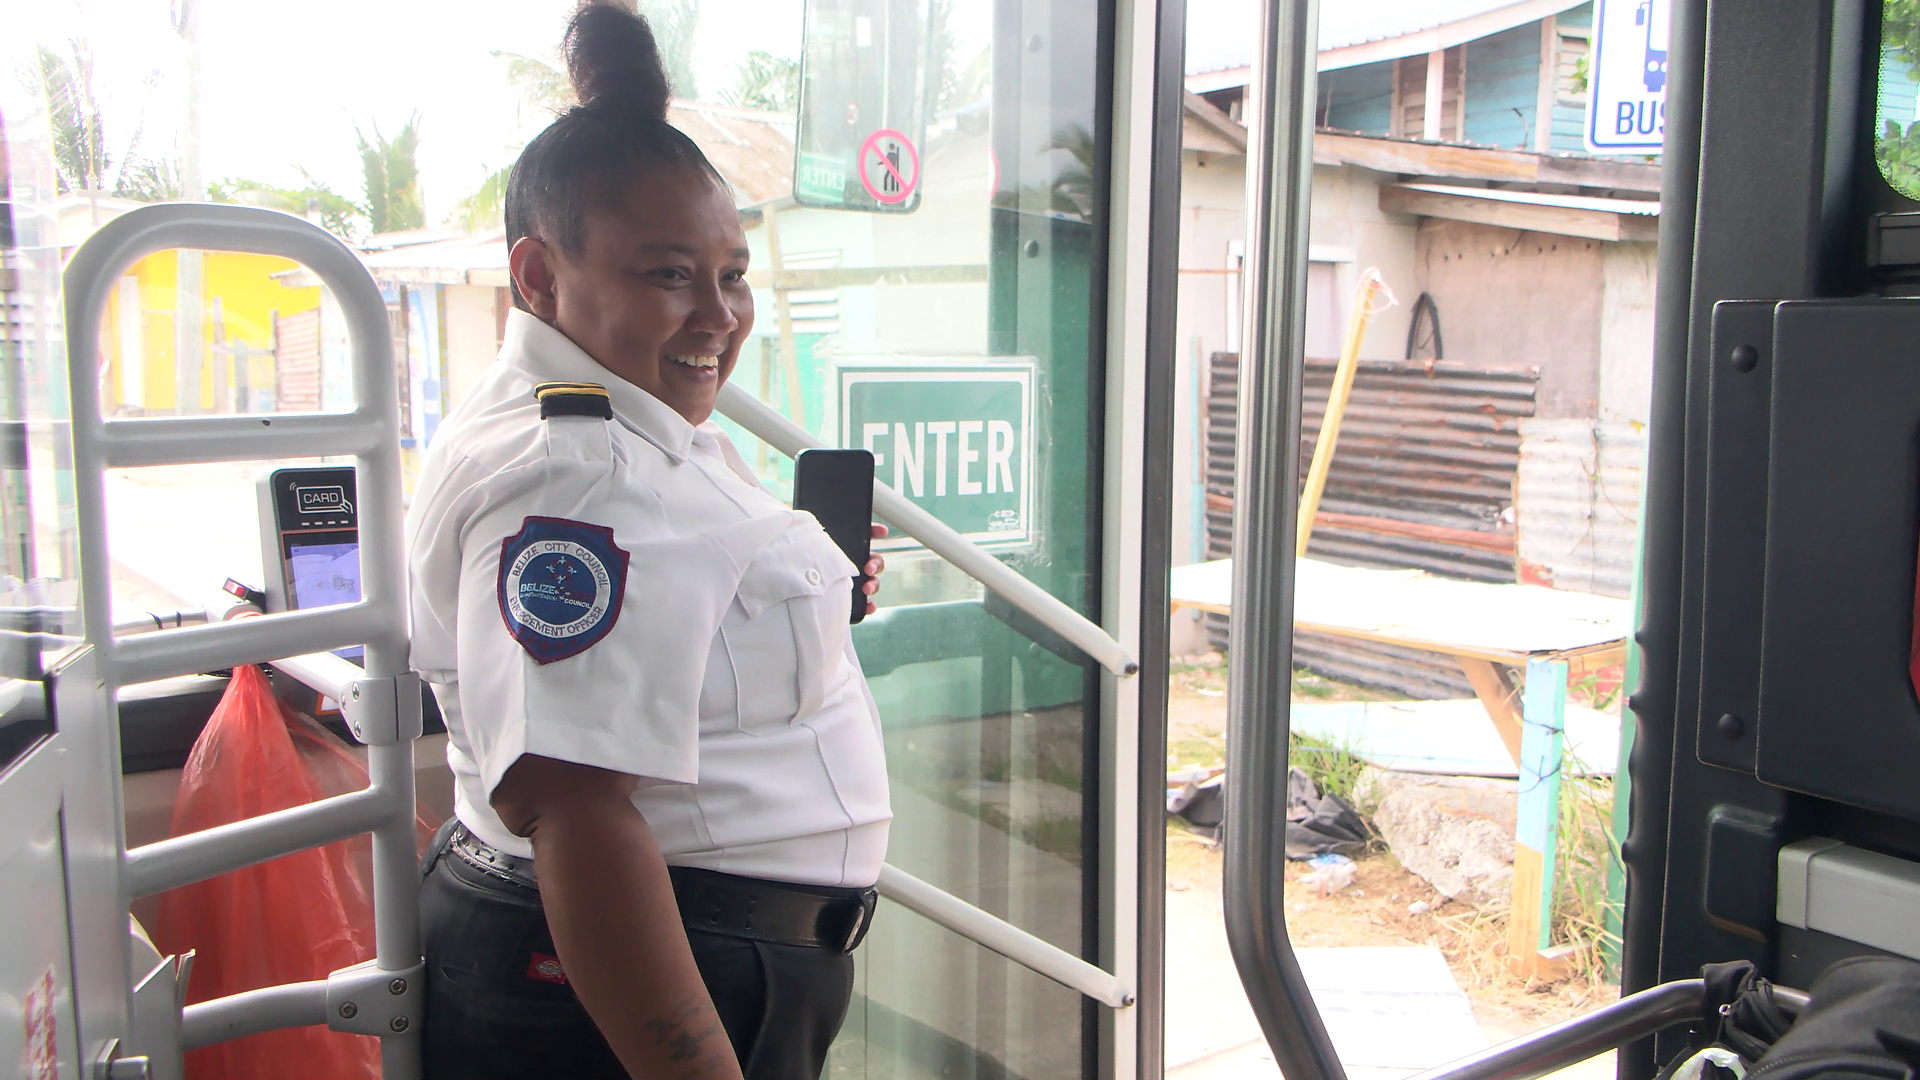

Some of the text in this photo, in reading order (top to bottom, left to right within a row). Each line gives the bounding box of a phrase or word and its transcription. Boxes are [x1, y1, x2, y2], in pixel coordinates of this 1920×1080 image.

[1615, 100, 1664, 135] BU
[303, 492, 339, 504] CARD
[512, 542, 609, 588] BELIZE CITY COUNCIL
[520, 583, 556, 595] BELIZE
[510, 595, 604, 636] ENFRCEMENT OFFICER
